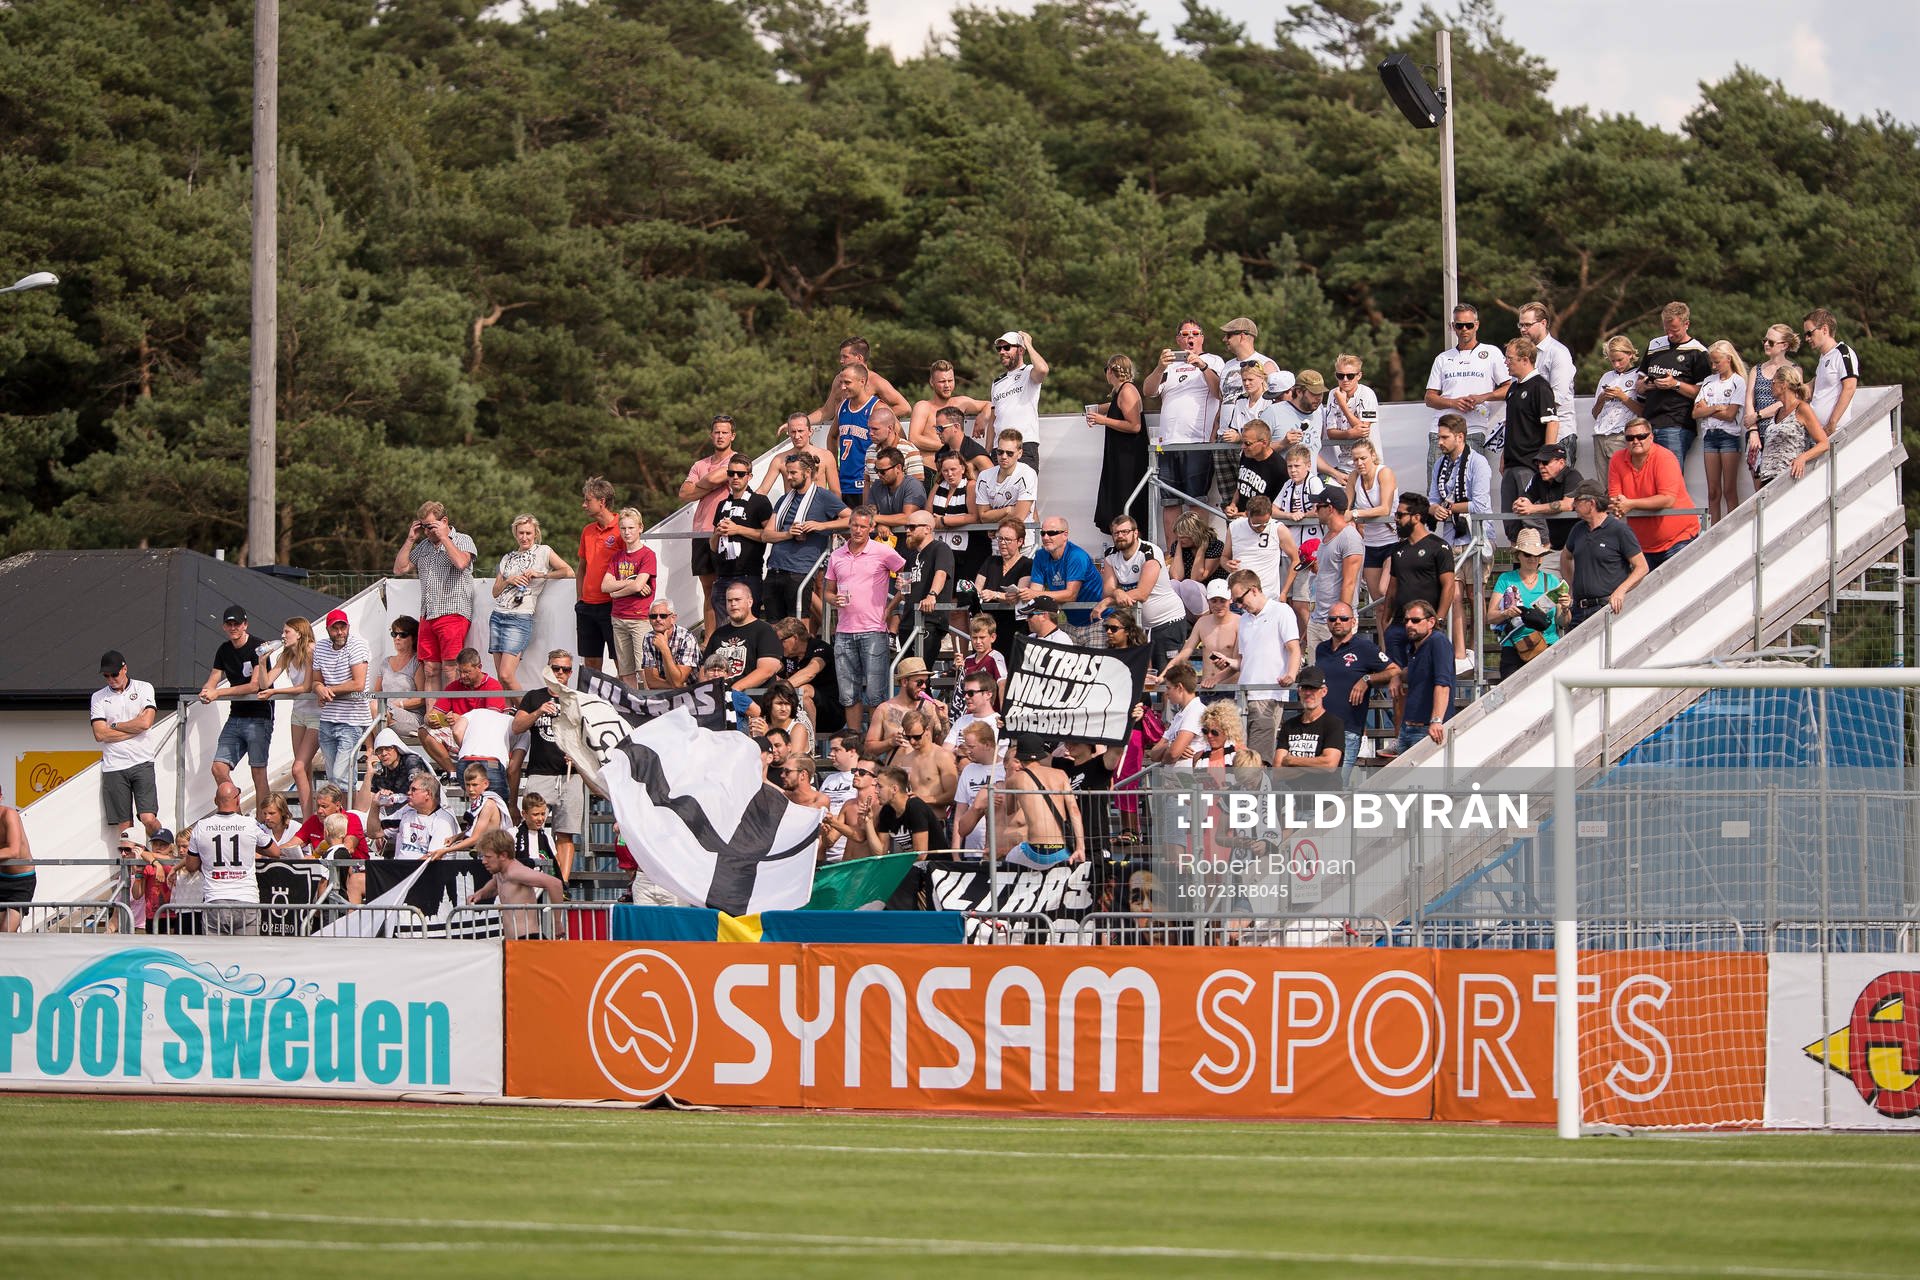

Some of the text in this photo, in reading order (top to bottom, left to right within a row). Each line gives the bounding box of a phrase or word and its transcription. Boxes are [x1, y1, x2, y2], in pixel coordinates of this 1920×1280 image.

[842, 439, 853, 460] 7
[1258, 533, 1270, 548] 3
[1021, 643, 1103, 683] ULTRAS
[1378, 651, 1389, 662] 8
[587, 676, 716, 716] ULTRAS
[205, 824, 247, 832] mätcenter
[212, 834, 242, 867] 11
[931, 861, 1093, 912] ULTRAS
[261, 921, 295, 934] ÖREBRO
[0, 975, 451, 1085] Pool Sweden
[713, 963, 1673, 1103] SYNSAM SPORTS
